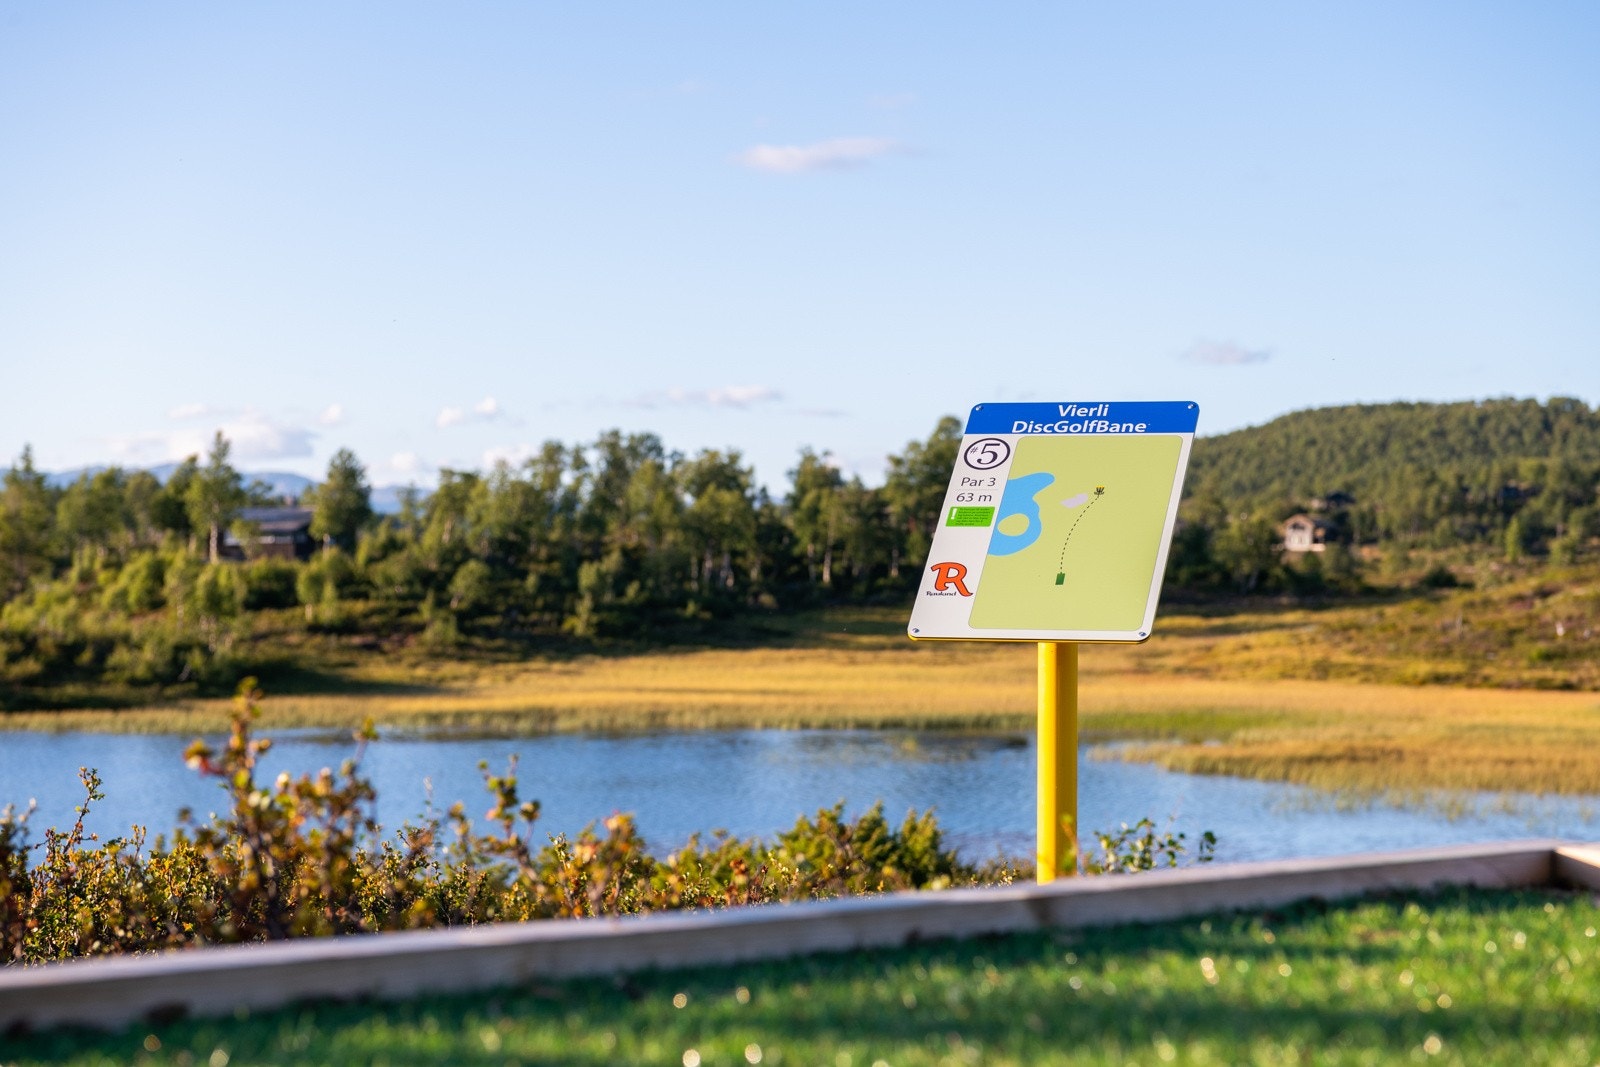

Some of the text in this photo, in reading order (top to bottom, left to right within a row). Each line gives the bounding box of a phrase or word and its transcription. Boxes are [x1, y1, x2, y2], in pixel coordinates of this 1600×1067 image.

[1058, 404, 1108, 417] Vierli
[1011, 420, 1147, 434] DiscGolfBane
[961, 477, 996, 487] Par 3
[956, 492, 992, 502] 63 m
[930, 562, 974, 597] R
